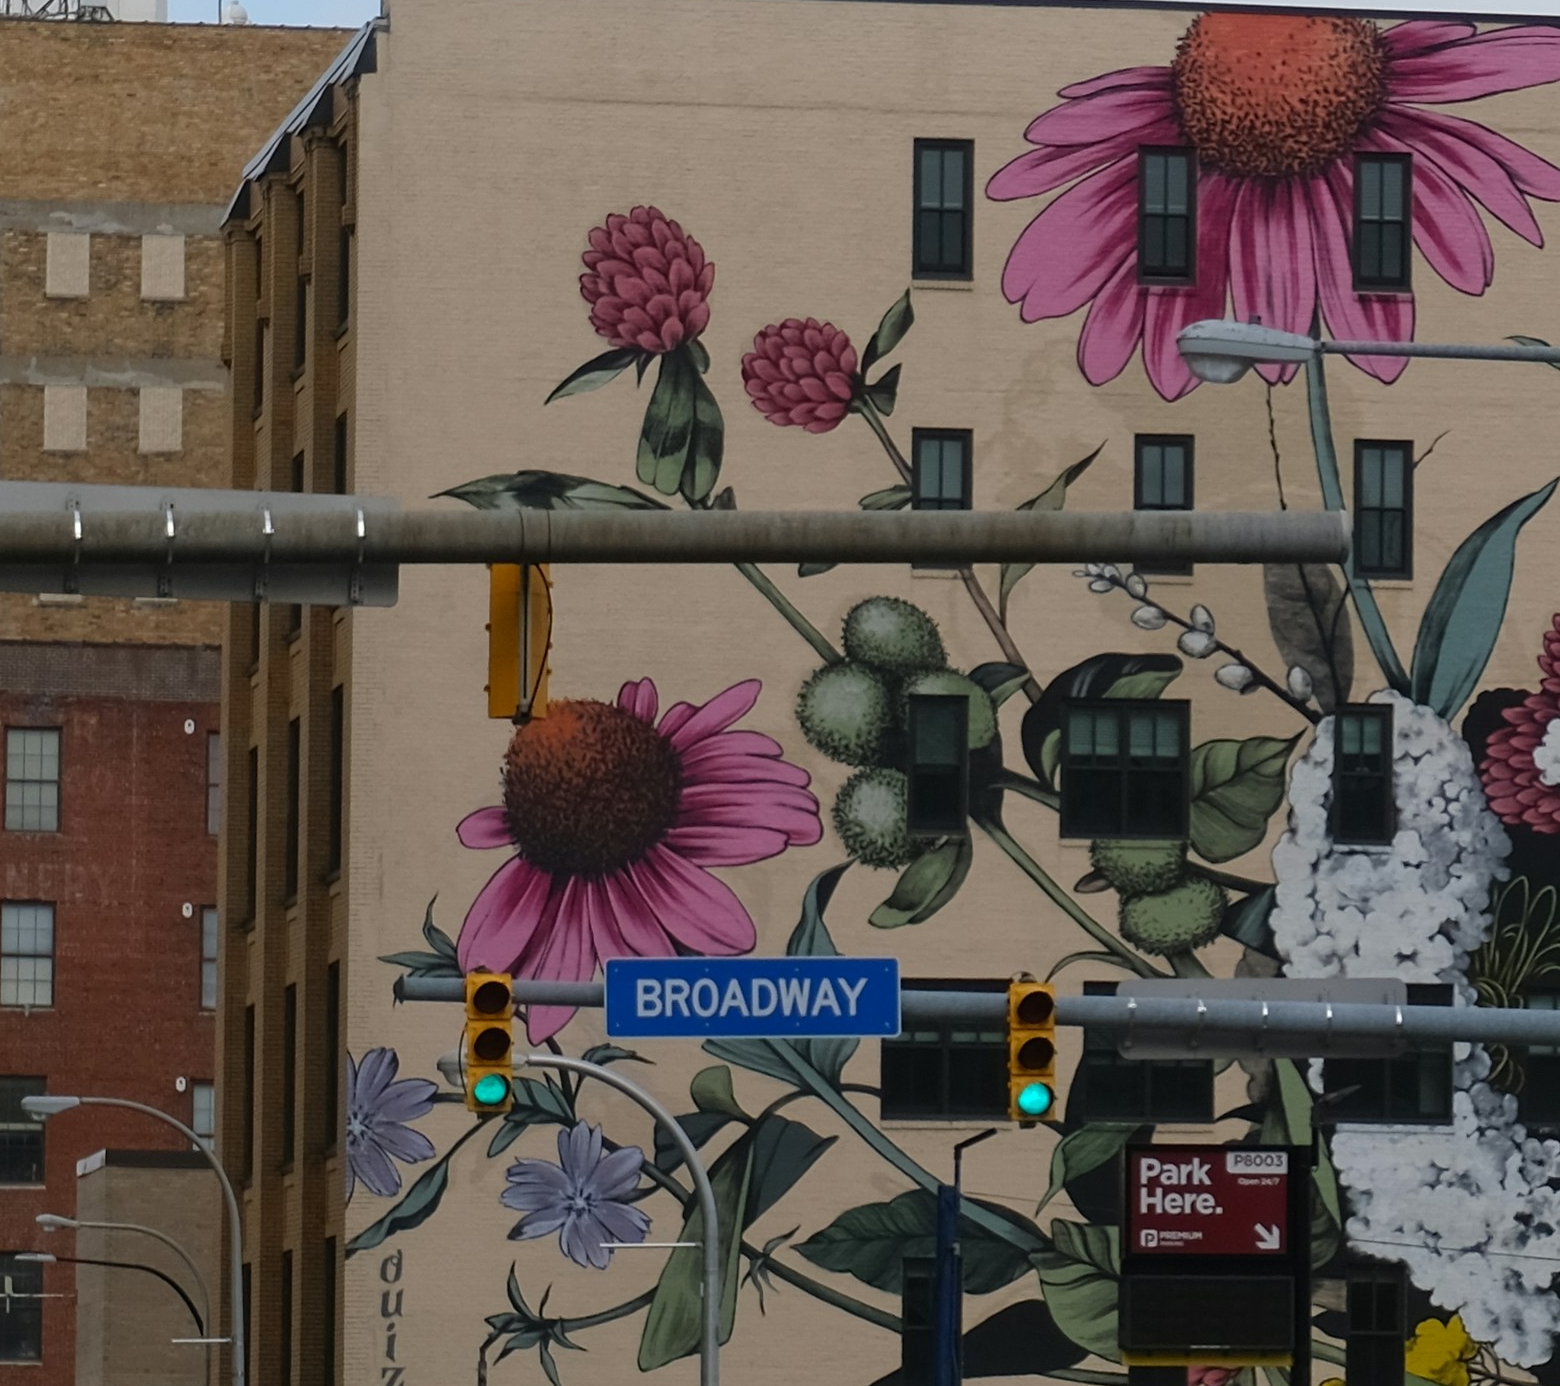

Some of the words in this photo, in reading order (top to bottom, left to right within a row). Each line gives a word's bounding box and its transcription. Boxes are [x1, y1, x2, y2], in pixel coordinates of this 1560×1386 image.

[637, 977, 869, 1017] BROADWAY
[1140, 1157, 1212, 1185] Park
[1234, 1154, 1284, 1167] P8003
[1140, 1187, 1224, 1214] Here.
